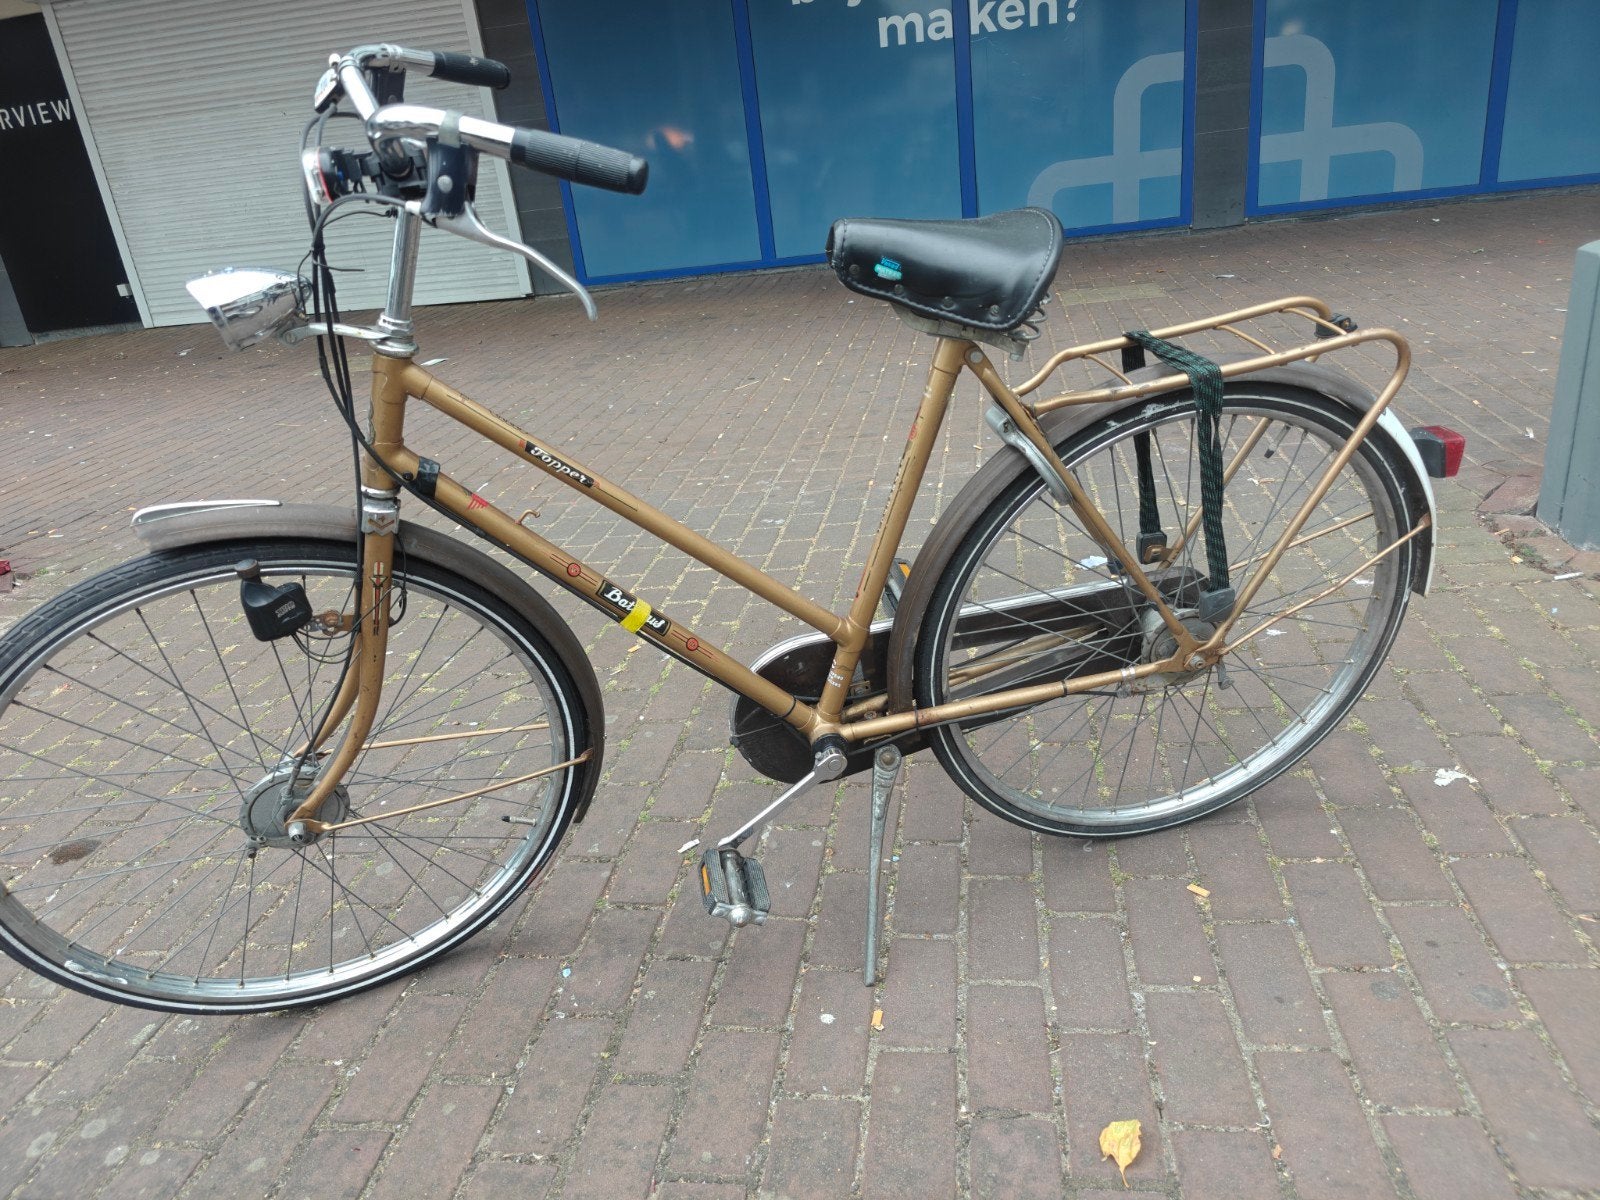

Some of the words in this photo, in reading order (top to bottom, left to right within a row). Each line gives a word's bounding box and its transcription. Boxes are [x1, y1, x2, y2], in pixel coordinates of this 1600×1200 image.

[0, 98, 71, 130] RVIEW
[530, 446, 588, 484] Topper
[604, 587, 666, 628] Batus
